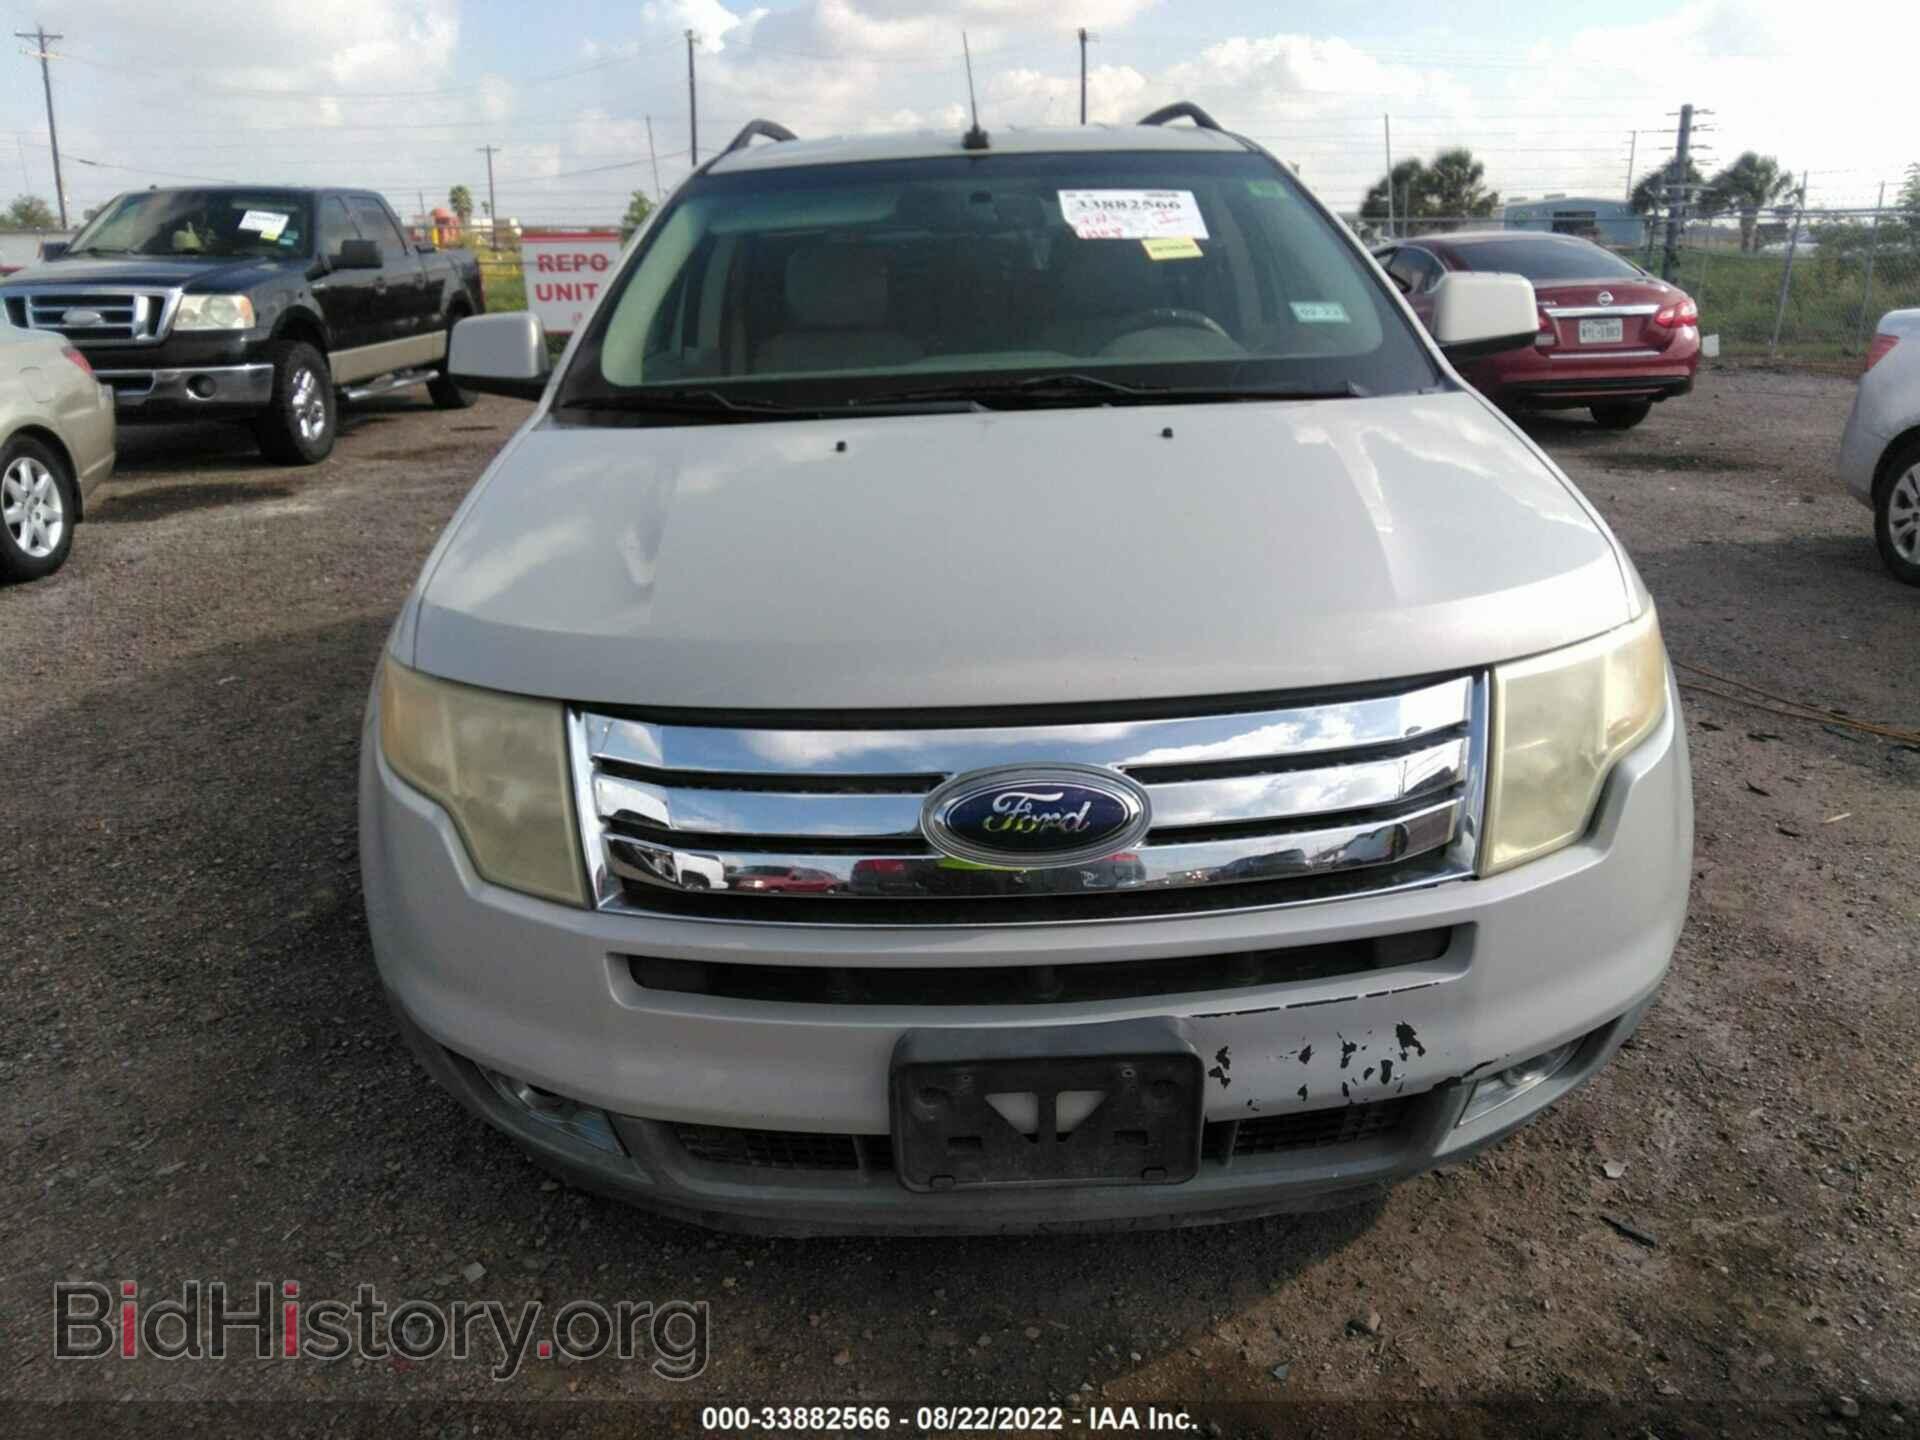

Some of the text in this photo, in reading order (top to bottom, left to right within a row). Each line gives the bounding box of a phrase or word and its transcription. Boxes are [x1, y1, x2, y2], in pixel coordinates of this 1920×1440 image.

[537, 253, 608, 272] REPO
[535, 283, 598, 301] UNIT
[983, 792, 1092, 833] Ford
